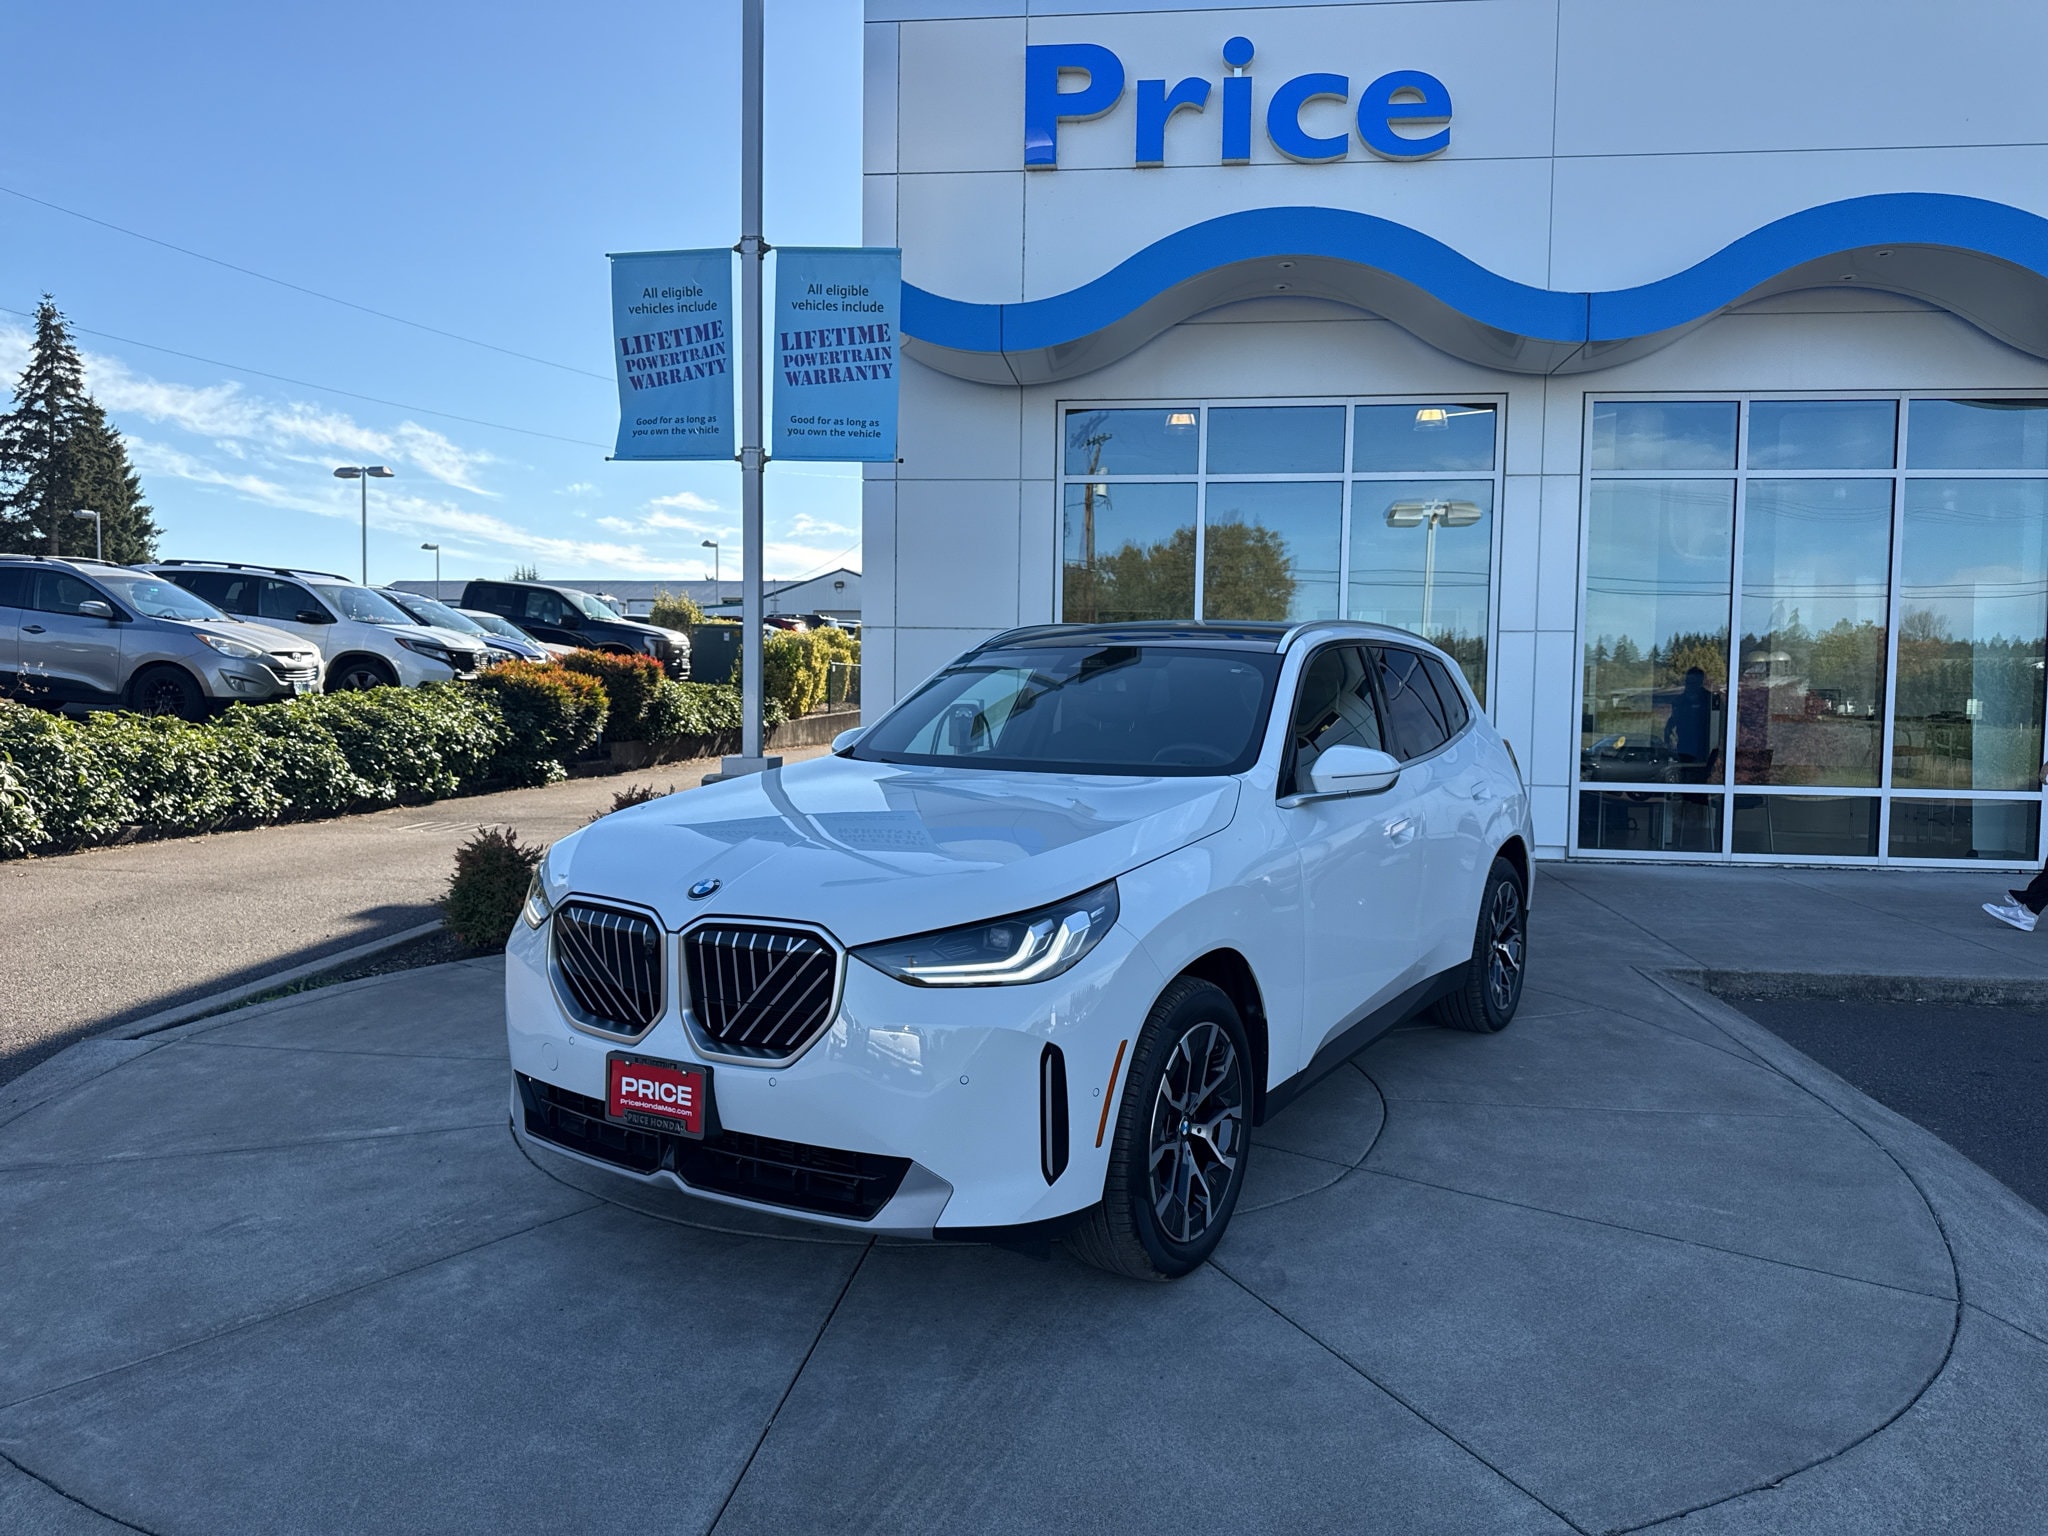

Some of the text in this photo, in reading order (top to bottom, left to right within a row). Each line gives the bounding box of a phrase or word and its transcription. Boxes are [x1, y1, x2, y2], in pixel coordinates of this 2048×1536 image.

[1024, 36, 1453, 170] Price
[642, 285, 703, 301] All eligible
[807, 283, 869, 299] All eligible
[628, 300, 718, 315] vehicles include
[791, 299, 885, 313] vehicles include
[620, 319, 725, 357] LIFETIME
[780, 323, 891, 352] LIFETIME
[625, 341, 726, 373] POWERTRAIN
[783, 346, 892, 369] POWERTRAIN
[628, 357, 728, 391] WARRANTY
[785, 363, 893, 387] WARRANTY
[636, 416, 658, 426] Good
[659, 415, 673, 424] for
[686, 415, 706, 426] long
[707, 415, 717, 423] as
[790, 415, 880, 429] Good for as long as
[632, 426, 720, 438] you own the vehicle
[787, 428, 882, 439] you own the vehicle
[621, 1076, 692, 1107] PRICE
[620, 1098, 693, 1117] PriceHondaMac.com
[627, 1113, 681, 1132] PRICE HONDA
